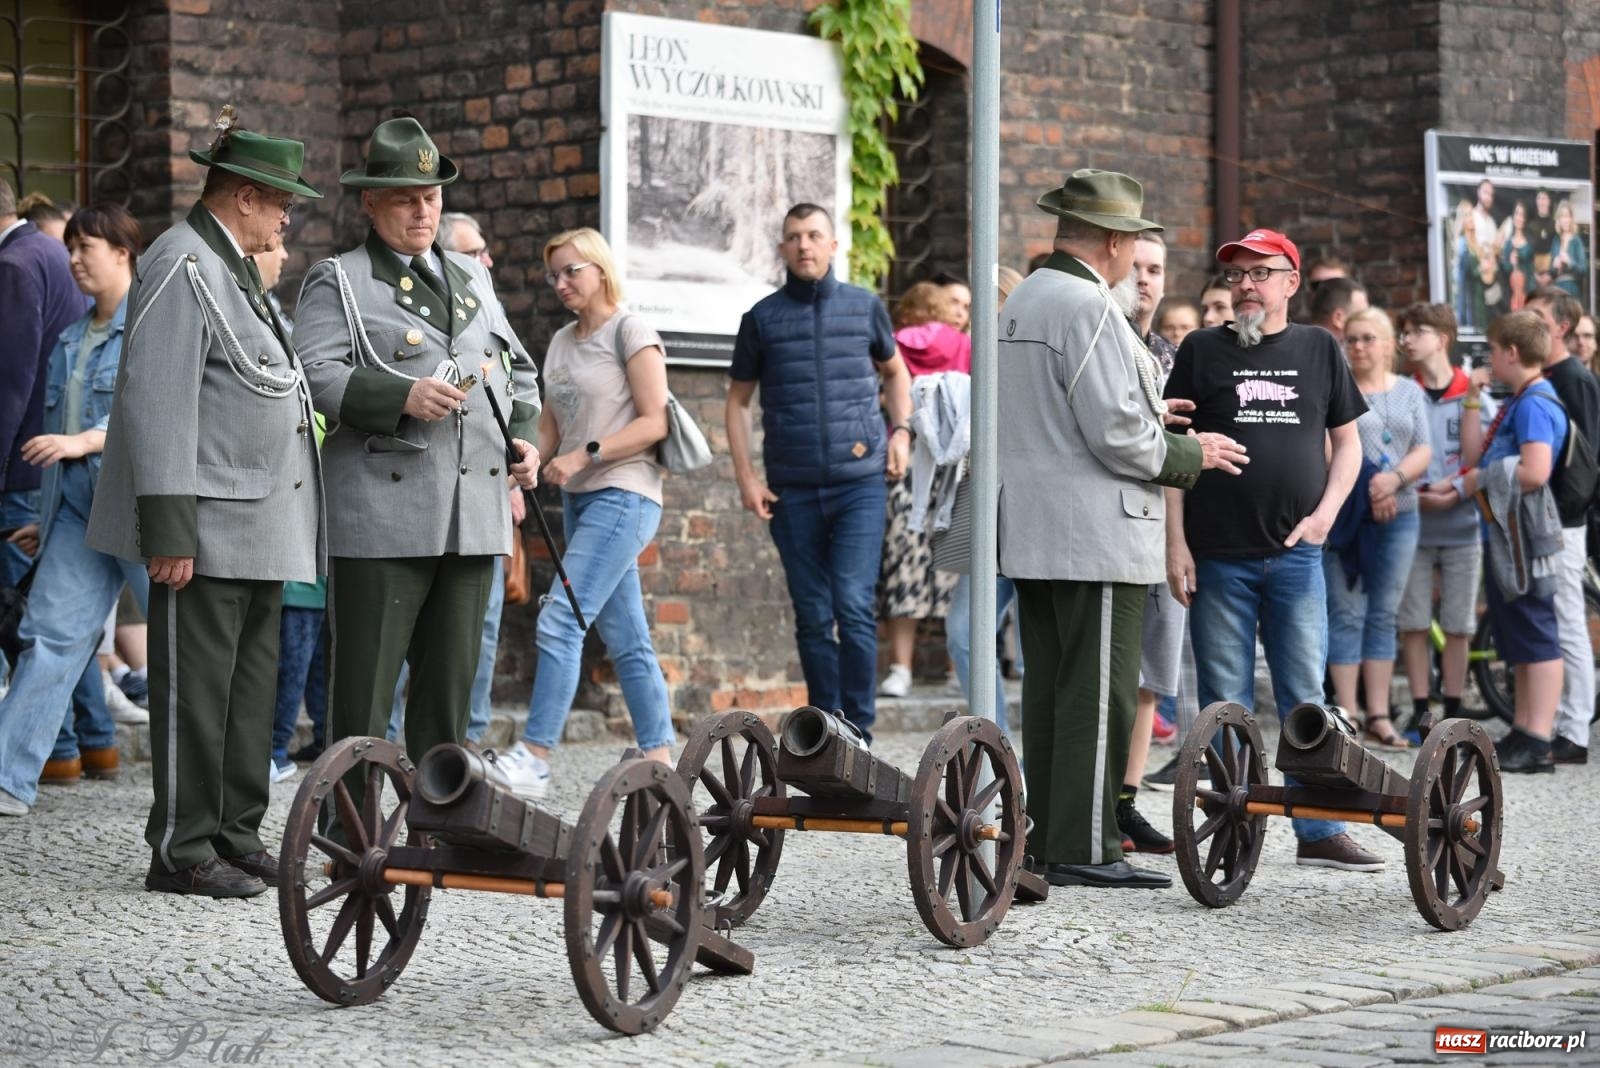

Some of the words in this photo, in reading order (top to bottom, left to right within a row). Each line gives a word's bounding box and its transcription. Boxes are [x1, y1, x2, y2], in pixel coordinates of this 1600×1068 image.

[629, 33, 688, 64] LEON
[629, 63, 824, 110] WYCZÓŁKOWSKI
[1495, 145, 1508, 164] W
